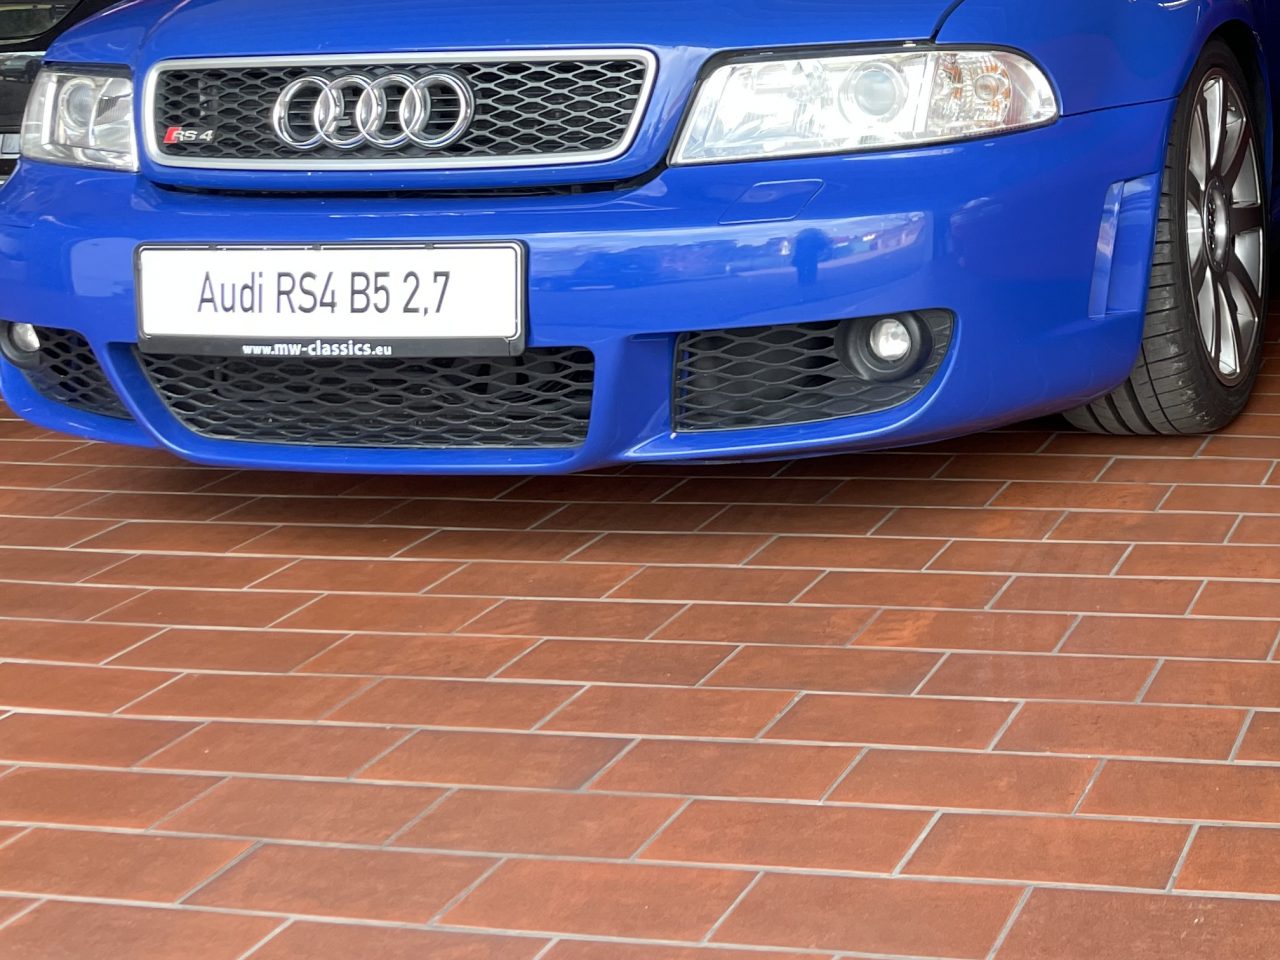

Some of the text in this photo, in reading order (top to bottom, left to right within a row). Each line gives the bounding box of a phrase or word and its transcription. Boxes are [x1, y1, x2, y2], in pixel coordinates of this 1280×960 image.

[197, 271, 451, 317] Audi RS4 B5 2,7
[241, 341, 392, 357] www.mw-classics.eu
